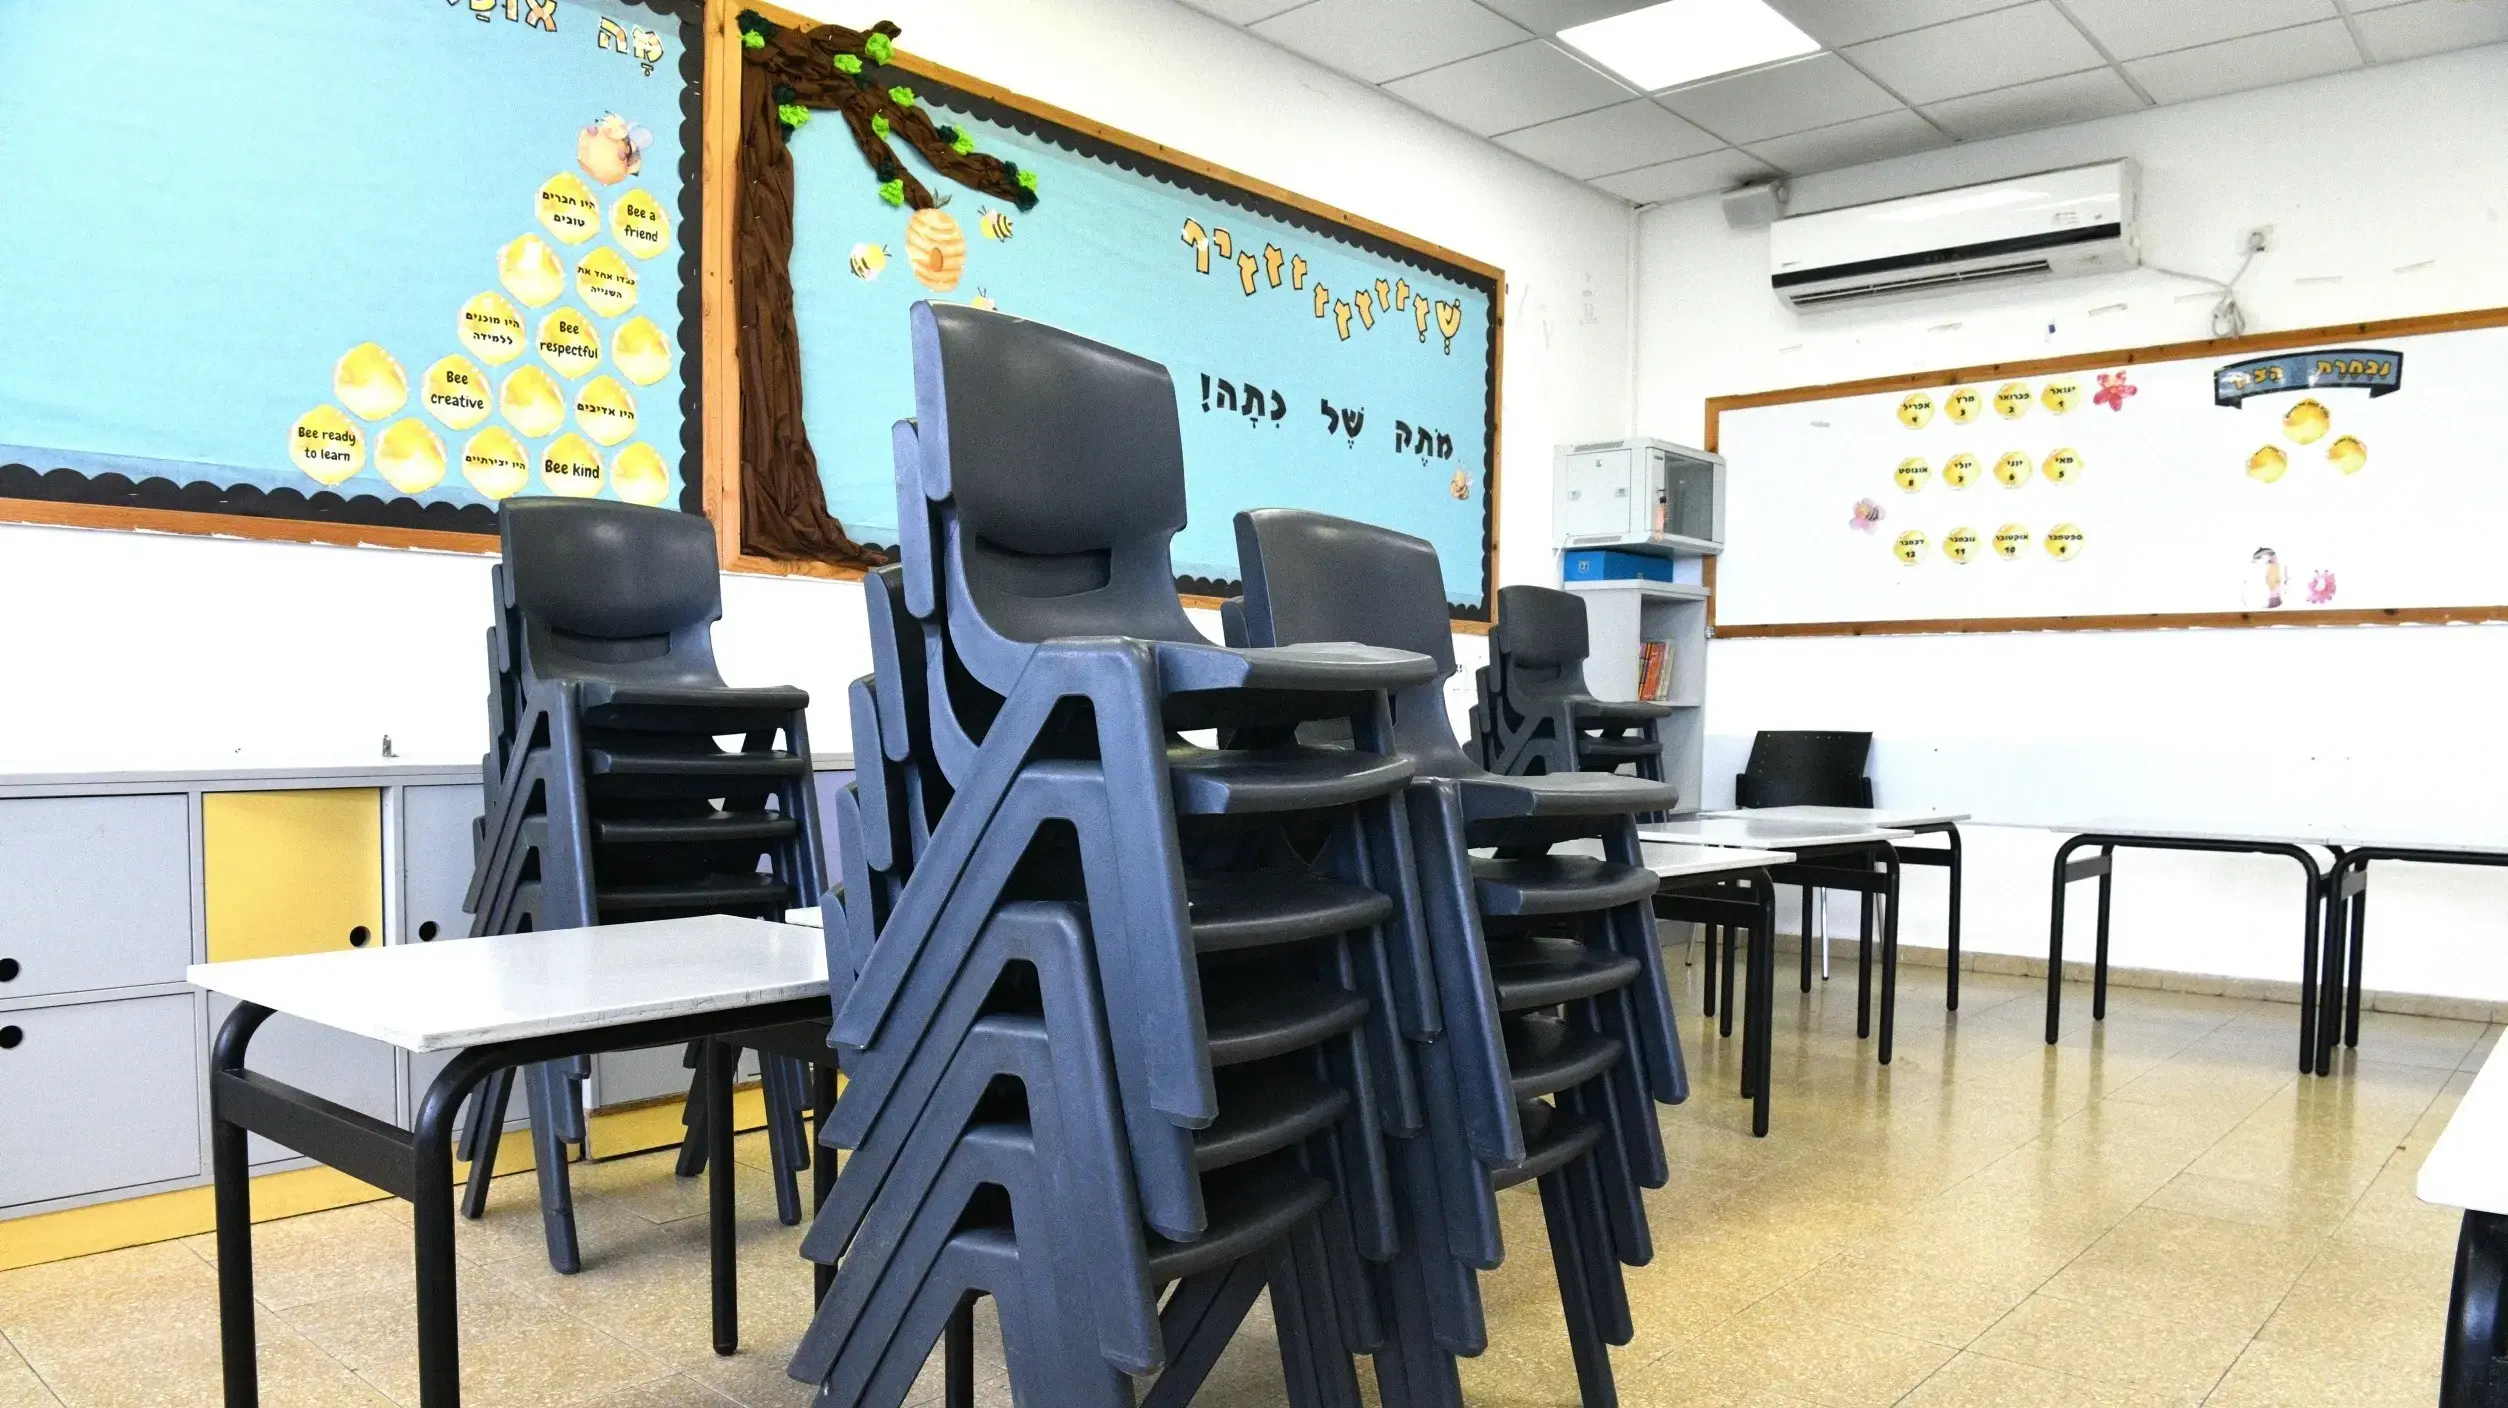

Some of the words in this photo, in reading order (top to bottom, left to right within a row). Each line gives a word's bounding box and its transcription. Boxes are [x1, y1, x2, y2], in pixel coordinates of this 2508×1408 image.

[542, 191, 577, 206] חברים
[580, 199, 595, 209] היו
[627, 204, 646, 219] Bee
[649, 211, 656, 222] a
[553, 213, 586, 227] טובים
[624, 224, 658, 242] friend
[577, 266, 591, 276] את
[594, 270, 613, 281] אחד
[590, 286, 622, 299] השנייה
[465, 312, 501, 325] מוכנים
[504, 319, 520, 329] היו
[559, 320, 580, 335] Bee
[473, 331, 513, 345] ללמידה
[540, 341, 598, 359] respectful
[446, 370, 469, 385] Bee
[430, 393, 484, 410] creative
[1955, 395, 1975, 404] מרץ
[1997, 392, 2030, 401] פברואר
[576, 402, 616, 416] אדיבים
[1902, 402, 1930, 411] אפריל
[619, 410, 635, 420] היו
[298, 426, 319, 439] Bee
[322, 430, 356, 447] ready
[304, 447, 317, 459] to
[320, 448, 351, 462] learn
[465, 455, 509, 467] יצירתיים
[512, 461, 526, 470] היו
[544, 459, 569, 475] Bee
[572, 462, 600, 479] kind
[1954, 461, 1972, 469] יולי
